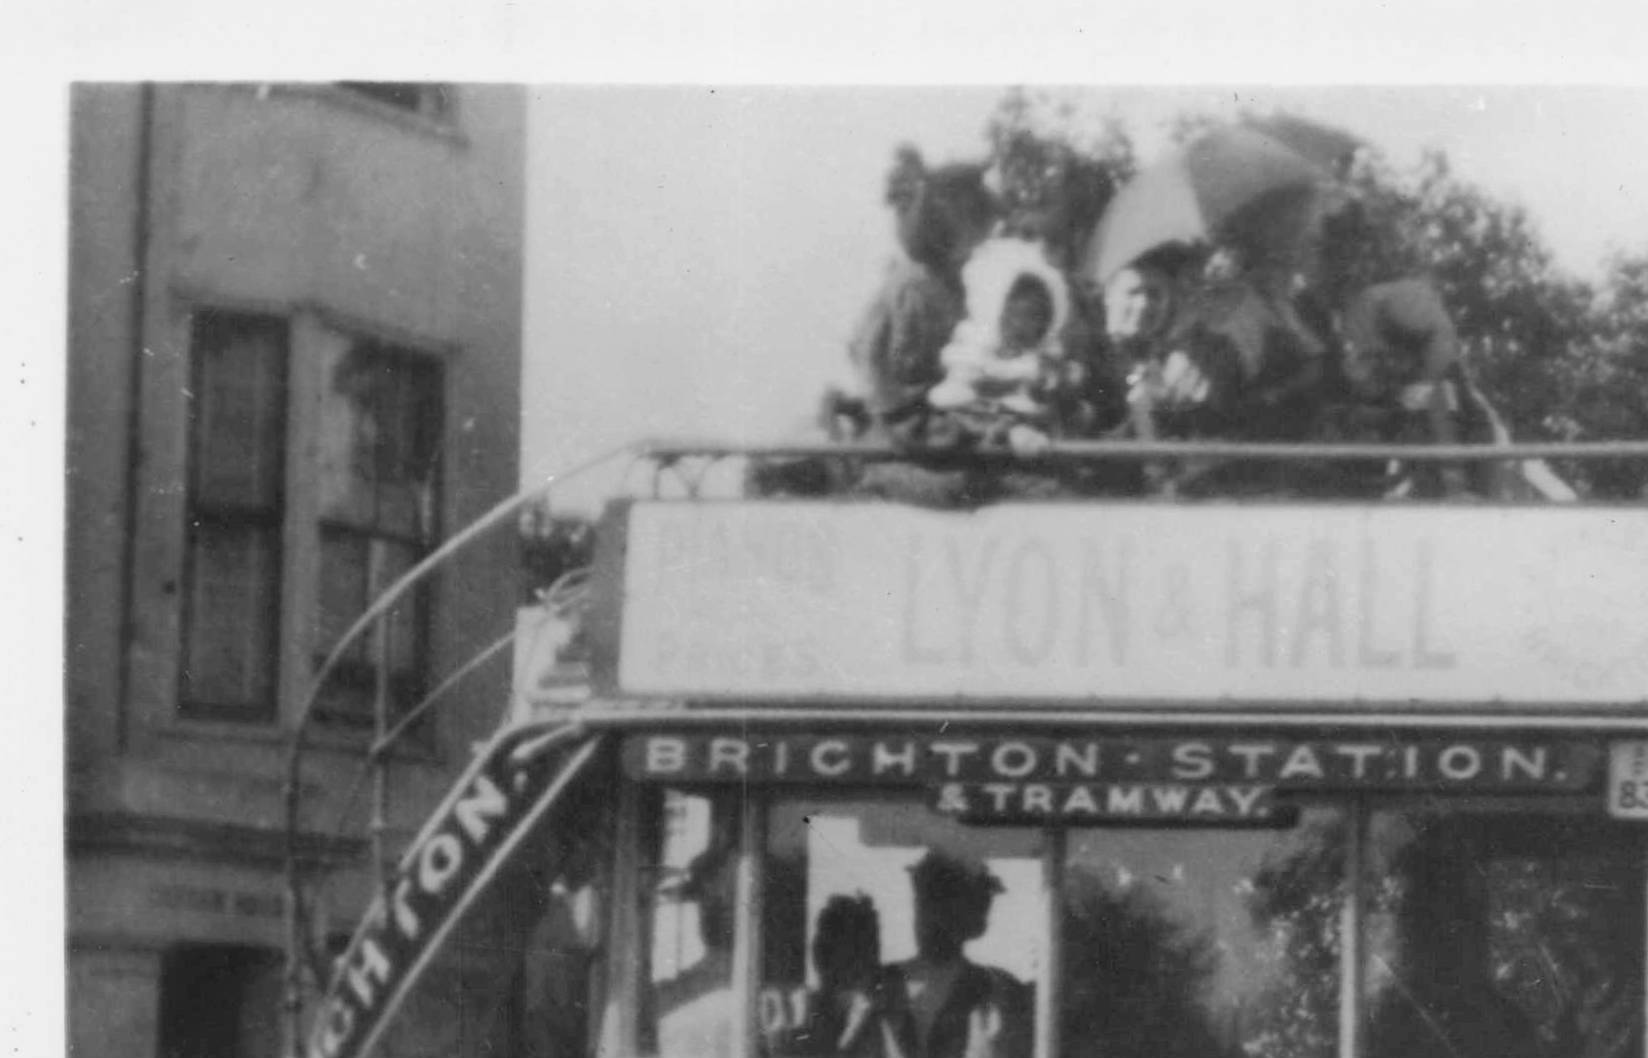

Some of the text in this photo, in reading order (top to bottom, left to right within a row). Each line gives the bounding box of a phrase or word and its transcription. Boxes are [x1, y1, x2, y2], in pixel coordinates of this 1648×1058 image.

[901, 532, 1132, 670] LYON
[1224, 535, 1458, 671] HALL
[645, 735, 1098, 777] BRIGHTON
[938, 782, 968, 811] &
